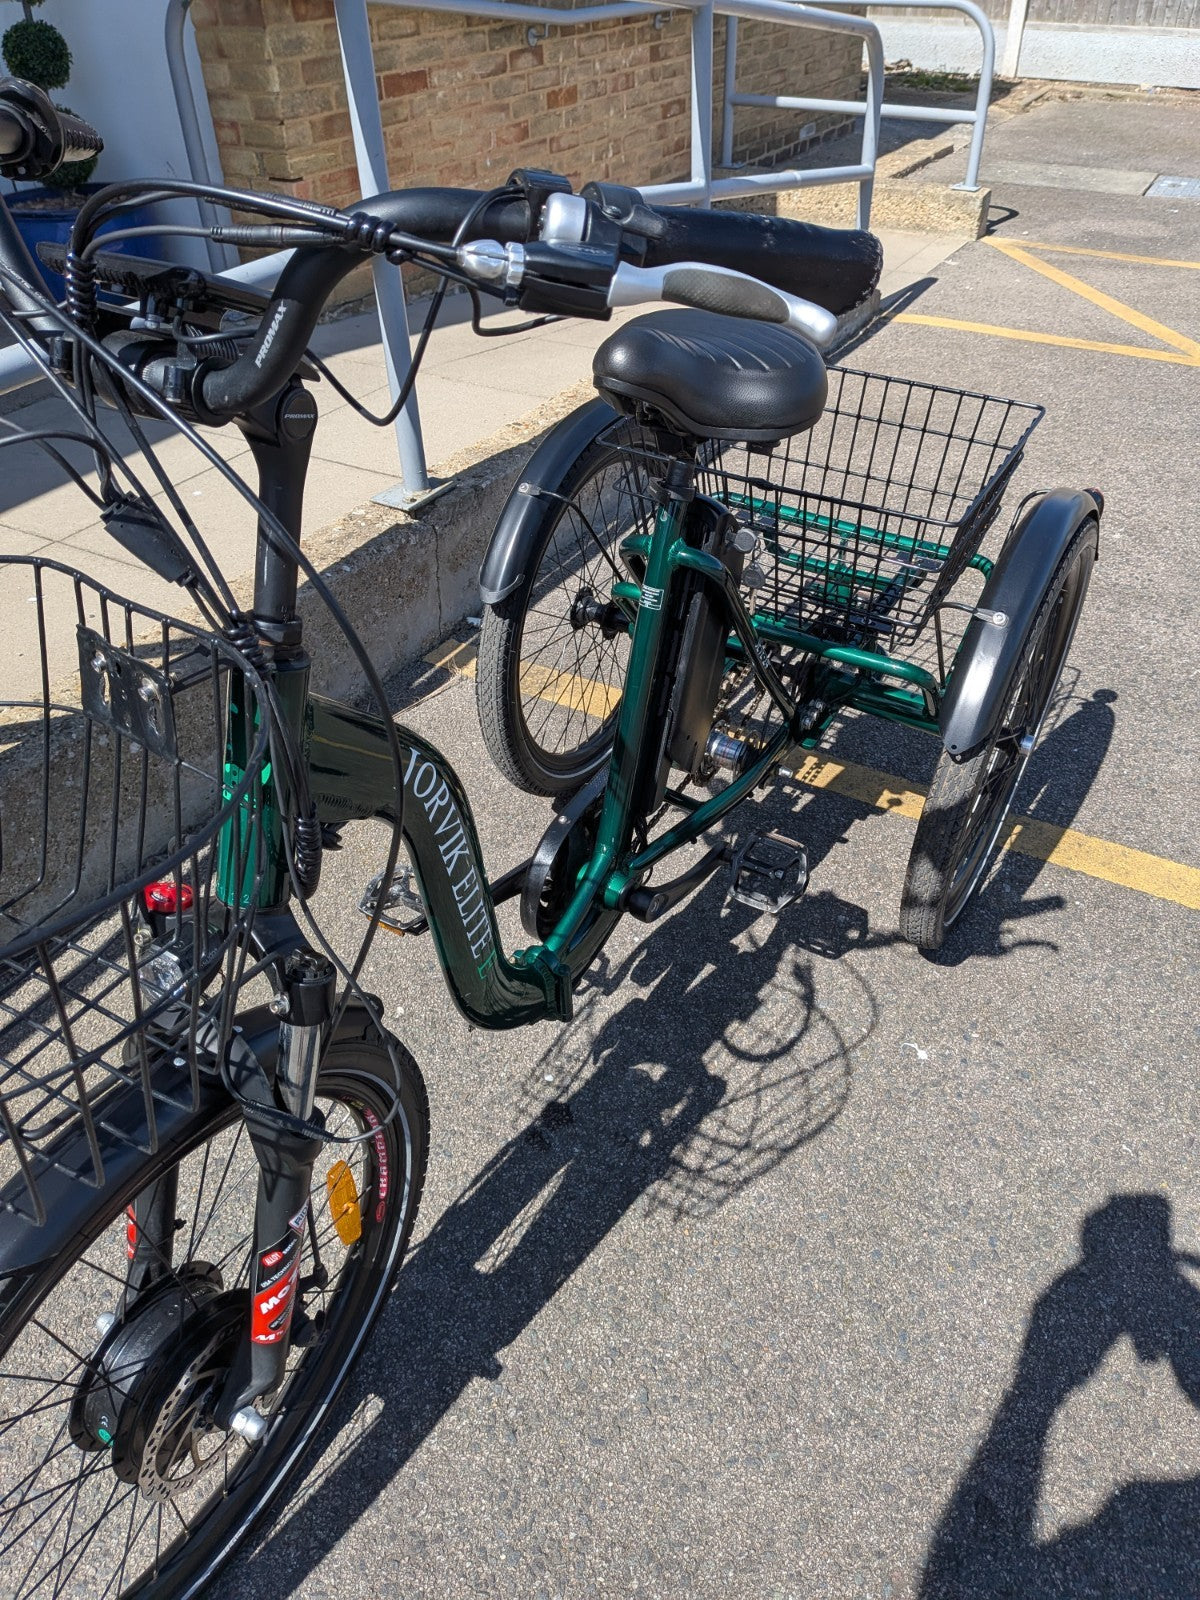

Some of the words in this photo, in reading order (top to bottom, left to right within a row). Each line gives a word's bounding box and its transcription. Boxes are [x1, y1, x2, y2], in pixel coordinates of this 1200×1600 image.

[255, 300, 287, 368] PROMAX
[452, 865, 493, 959] ELITE
[263, 1252, 281, 1266] ALLOY
